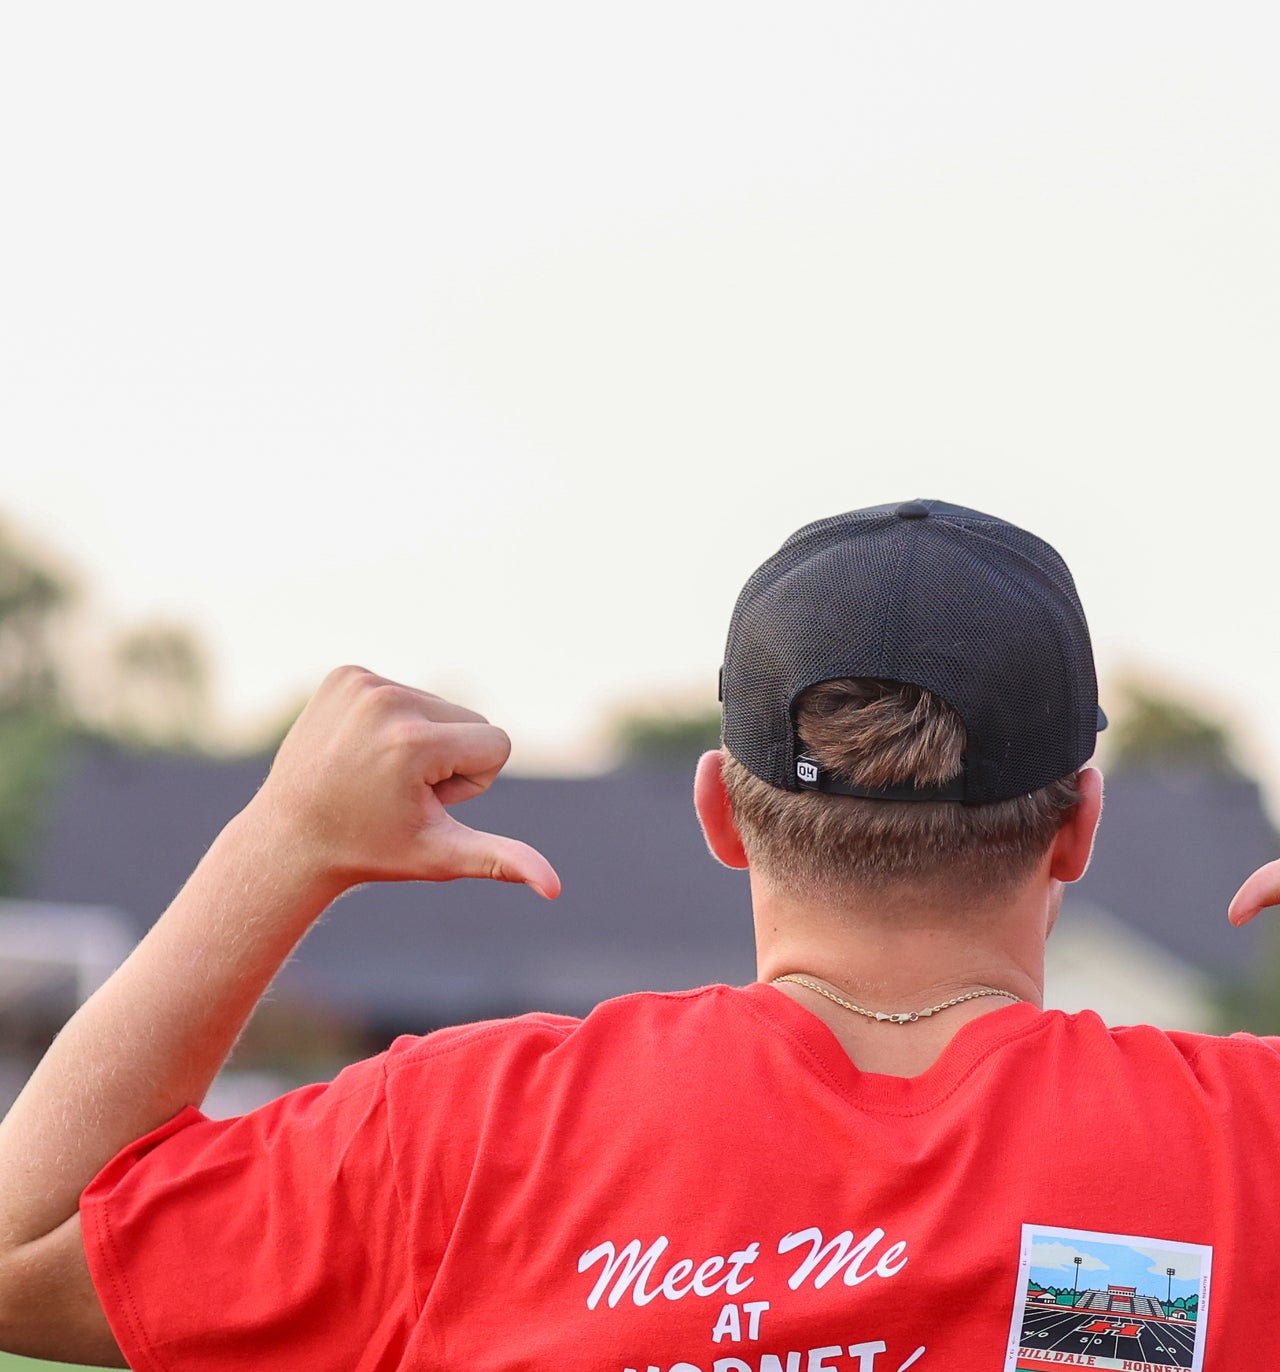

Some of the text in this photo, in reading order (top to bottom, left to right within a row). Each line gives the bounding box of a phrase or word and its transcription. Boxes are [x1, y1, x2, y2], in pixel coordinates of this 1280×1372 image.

[577, 1227, 908, 1310] Meet Me
[712, 1301, 770, 1343] AT
[1078, 1320, 1145, 1339] H
[1017, 1347, 1097, 1366] HILLDALE
